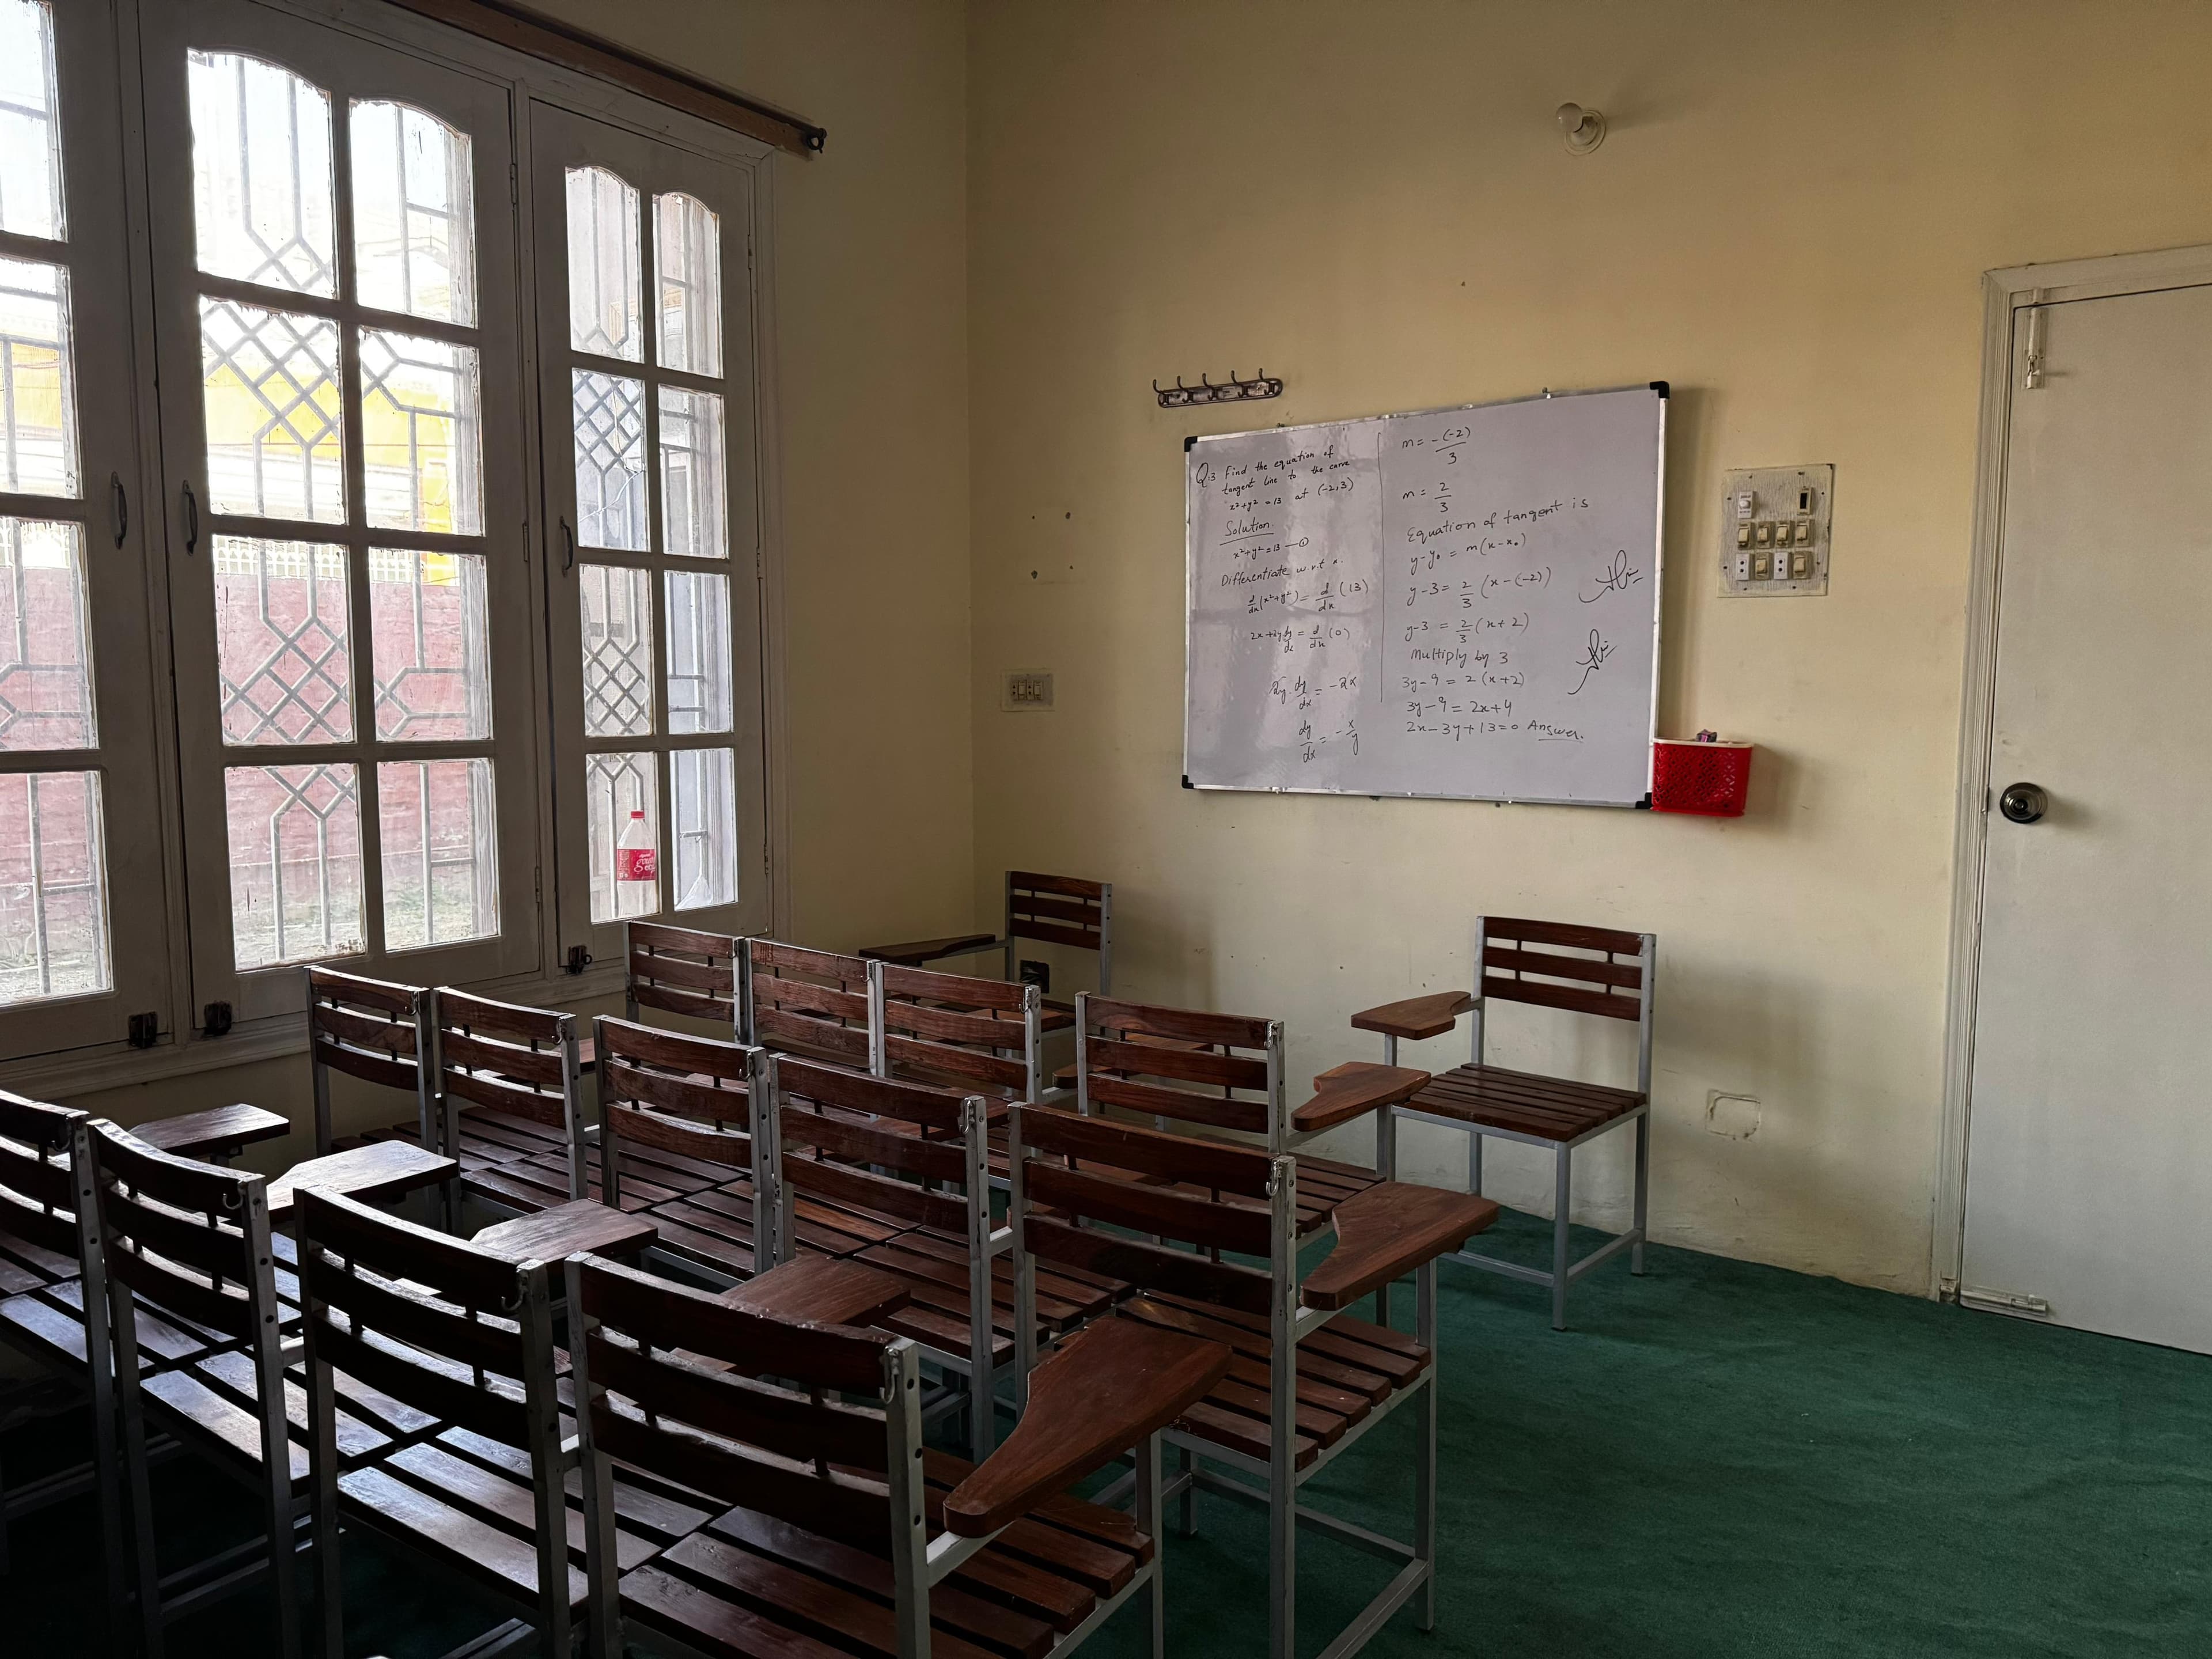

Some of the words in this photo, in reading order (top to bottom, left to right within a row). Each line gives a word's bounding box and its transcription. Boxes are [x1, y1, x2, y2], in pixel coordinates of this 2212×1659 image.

[1225, 464, 1248, 480] Find
[1255, 460, 1268, 472] the
[1274, 450, 1315, 470] equation
[1324, 445, 1334, 459] of
[1222, 478, 1255, 496] tangent
[1264, 474, 1278, 486] line
[1288, 469, 1296, 480] to
[1311, 464, 1323, 475] the
[1330, 460, 1350, 471] curve
[1295, 491, 1309, 501] at
[1407, 520, 1475, 544] Equation
[1483, 512, 1497, 528] of
[1503, 499, 1563, 524] tangent
[1573, 498, 1588, 509] is
[1221, 564, 1290, 586] Differentiate
[1411, 648, 1467, 669] Multiply
[1475, 650, 1489, 668] by
[1499, 652, 1508, 664] 3
